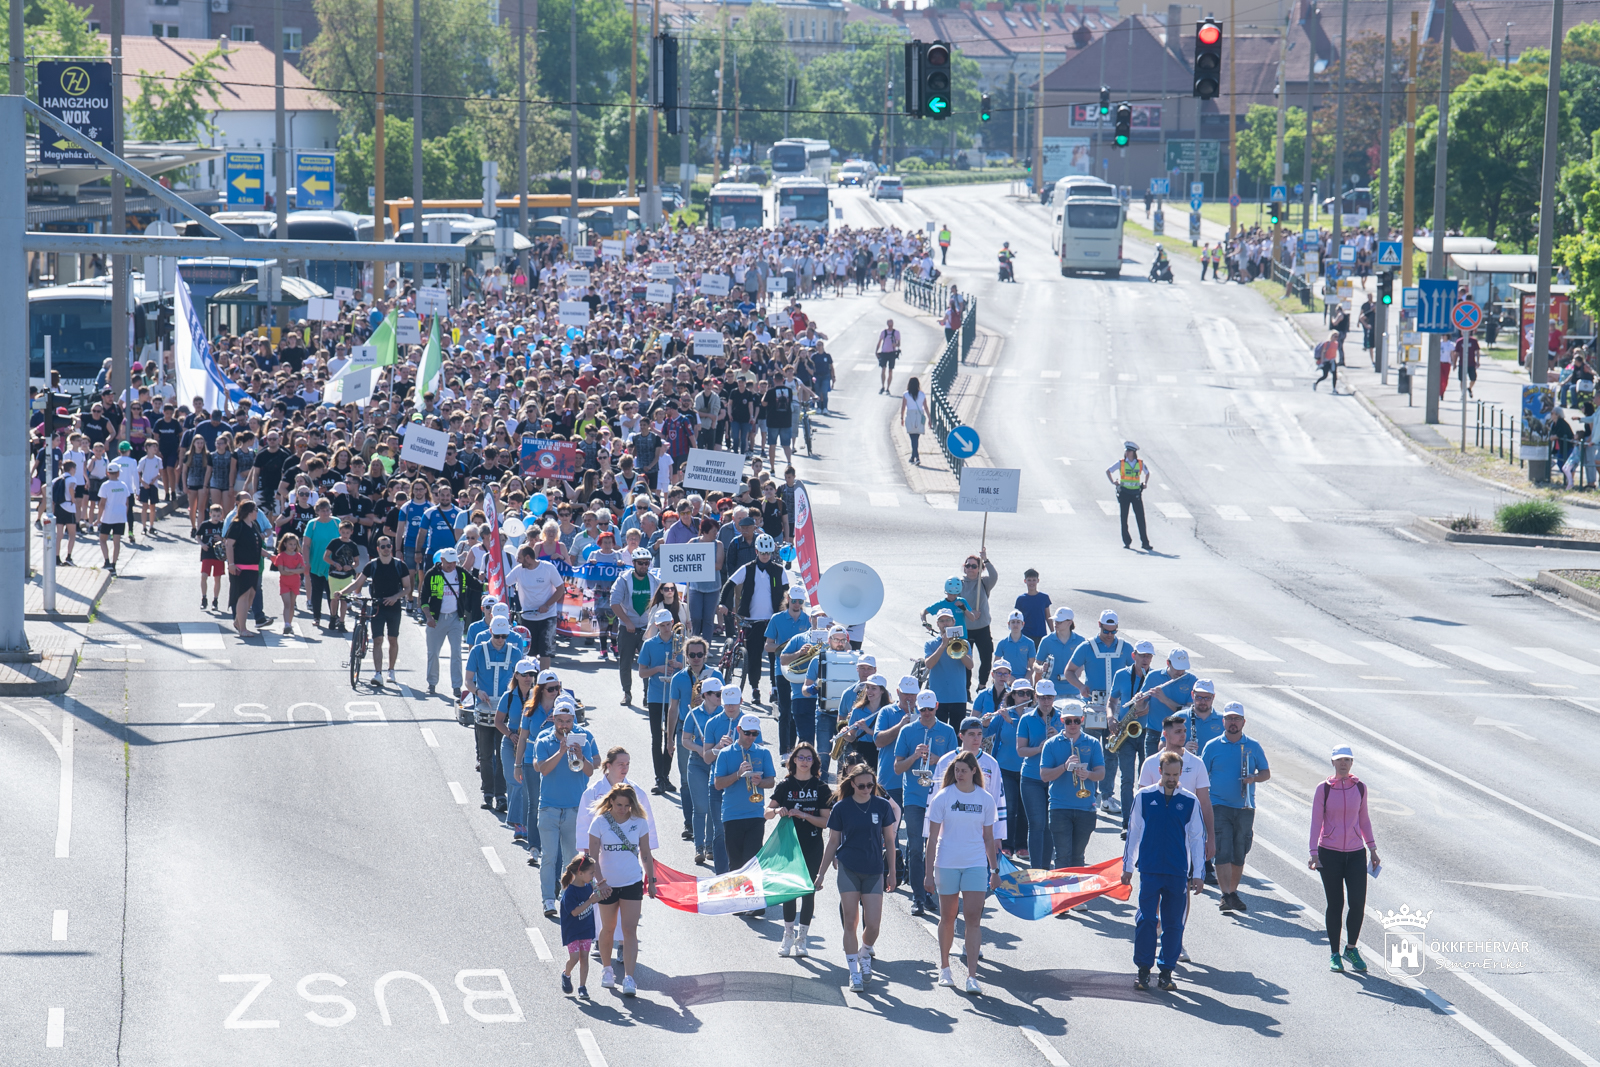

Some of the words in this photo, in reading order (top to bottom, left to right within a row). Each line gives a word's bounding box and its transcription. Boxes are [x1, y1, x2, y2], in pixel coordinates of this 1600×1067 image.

[43, 97, 109, 109] HANGZHOU
[62, 110, 91, 124] WOK
[44, 151, 83, 160] Megyeház
[416, 436, 436, 447] FEHÉRVÁR
[523, 439, 553, 447] FEHÉRVÁR
[554, 441, 574, 449] RUGBY
[433, 450, 439, 458] SE
[706, 459, 726, 468] NYITOTT
[692, 465, 736, 477] TORNATERMEKBEN
[687, 472, 712, 482] SPORTOLÓ
[712, 475, 738, 485] LAKOSSÁG
[978, 486, 992, 495] TRIÁL
[992, 487, 1000, 495] SE
[668, 554, 684, 563] SHS
[686, 553, 706, 562] KART
[672, 563, 703, 573] CENTER
[178, 701, 390, 729] BUSZ
[787, 788, 818, 798] SUDÁR
[218, 968, 527, 1030] BUSZ
